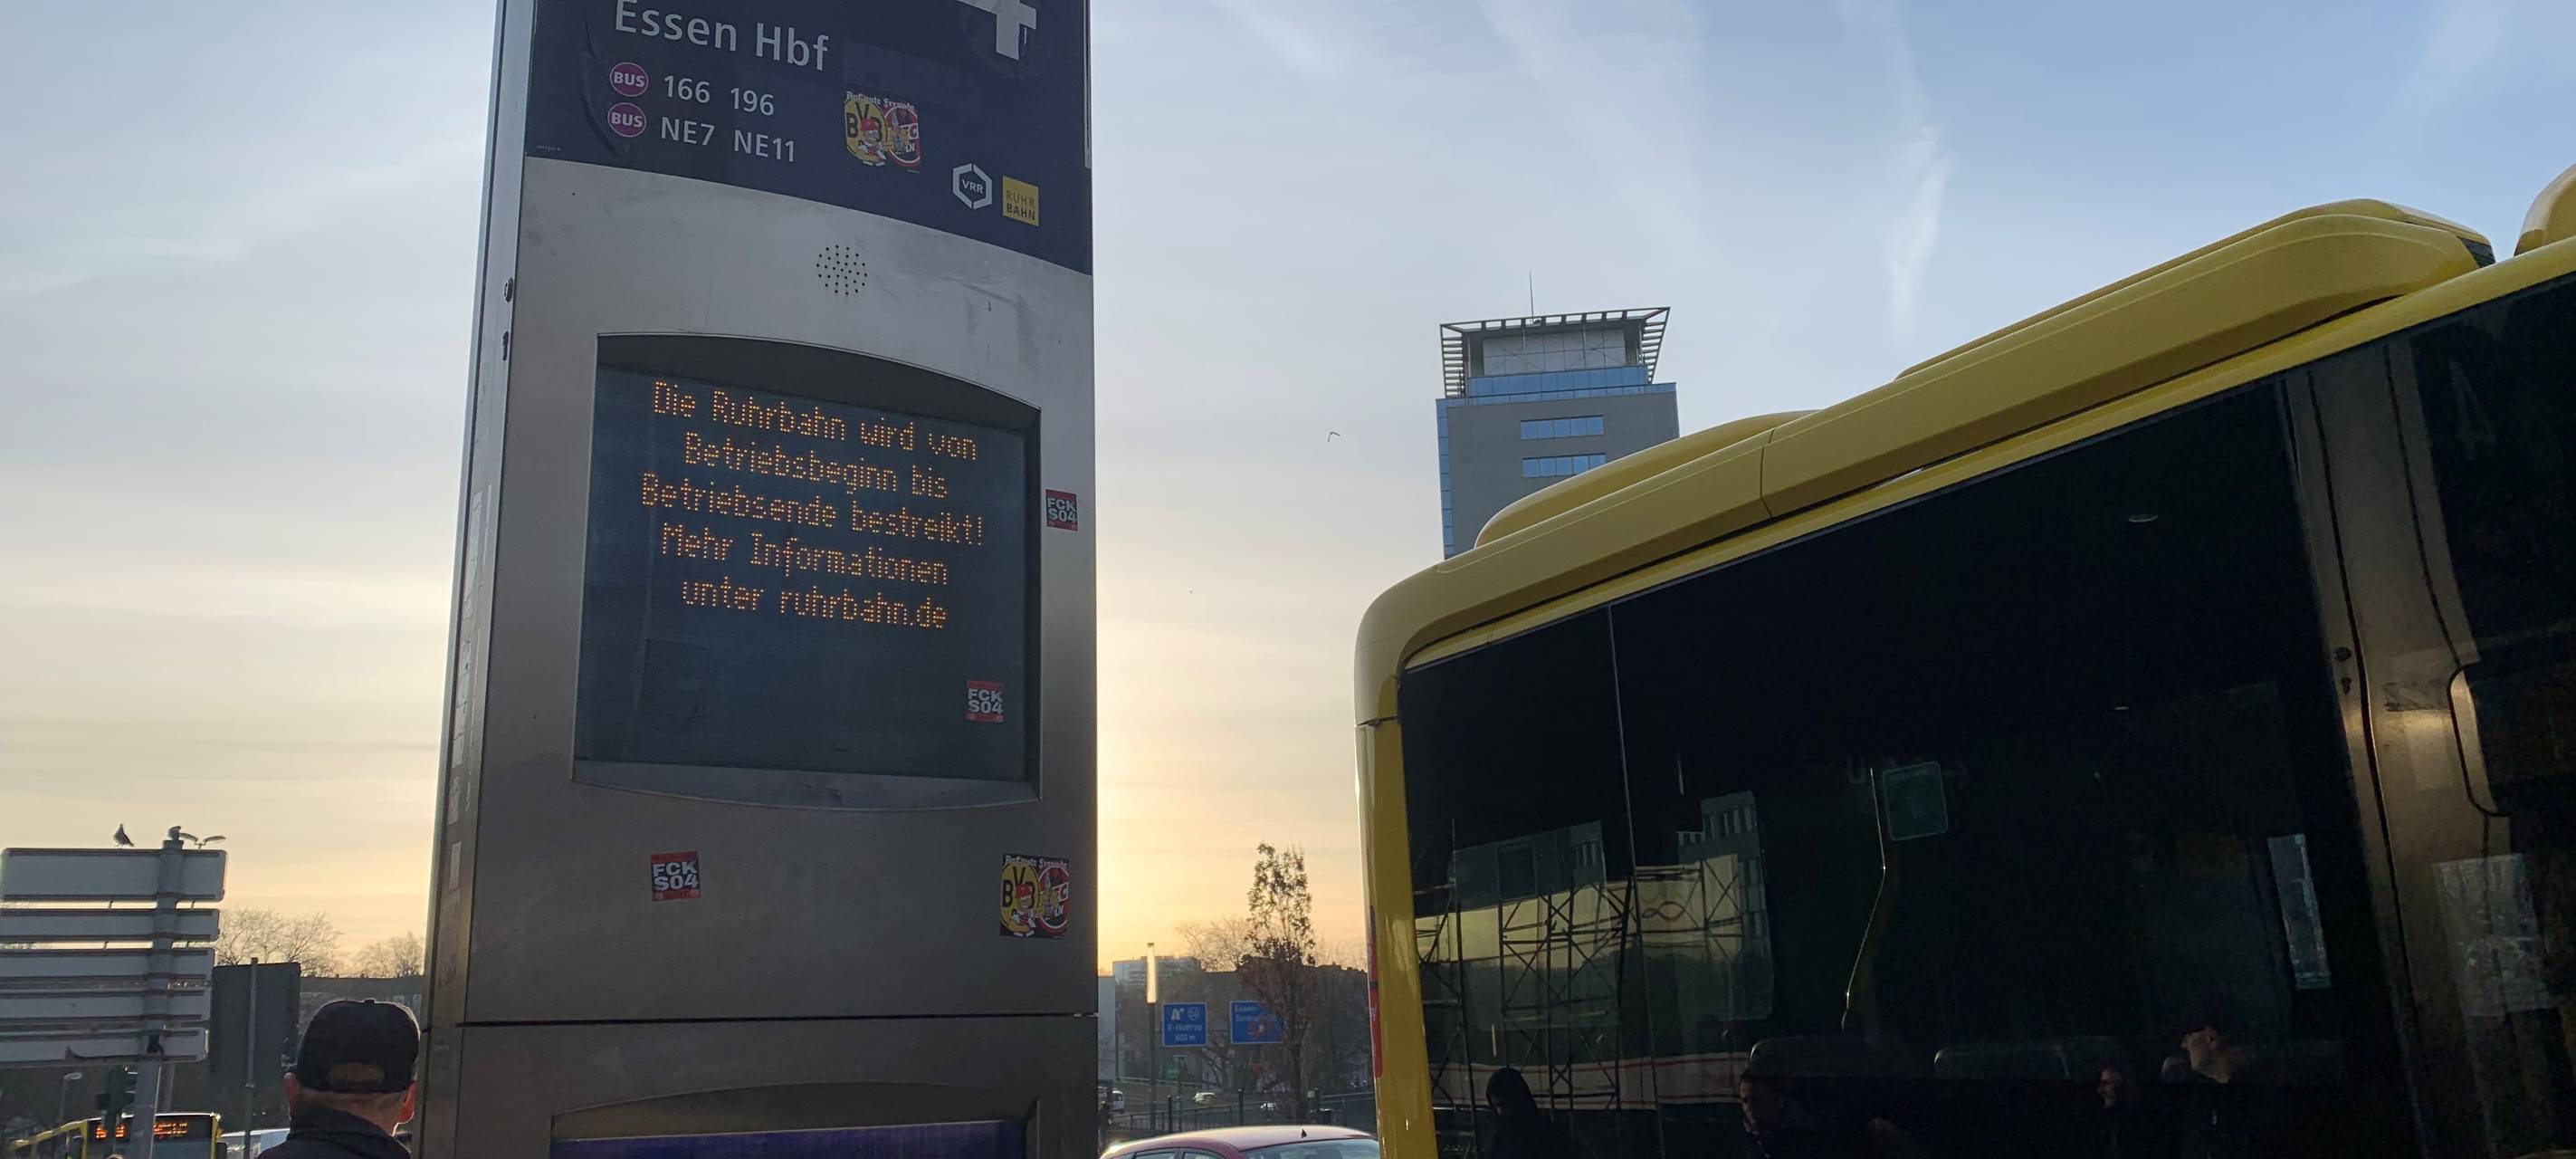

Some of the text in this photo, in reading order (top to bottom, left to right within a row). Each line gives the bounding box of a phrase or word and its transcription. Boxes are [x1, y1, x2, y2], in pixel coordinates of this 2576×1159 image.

[615, 0, 830, 71] Essen Hbf
[613, 72, 775, 116] BUS 166 196
[610, 112, 795, 163] BUS NE7 NE11
[961, 178, 984, 194] VRR
[1006, 189, 1035, 209] RUHR
[1007, 203, 1035, 221] BAHN
[654, 381, 978, 461] Die Ruhrbahn wird von
[683, 431, 949, 499] Betriebsbeginn bis
[641, 472, 983, 545] Betriebsende bestreikt!
[1047, 497, 1076, 512] FCK
[1048, 508, 1076, 523] S04
[662, 522, 949, 586] Mehr Informationen
[682, 576, 949, 628] unter ruhrbahn.de
[968, 688, 1003, 703] FCK
[968, 700, 1003, 714] S04
[652, 860, 697, 876] FCK
[654, 874, 699, 891] S04
